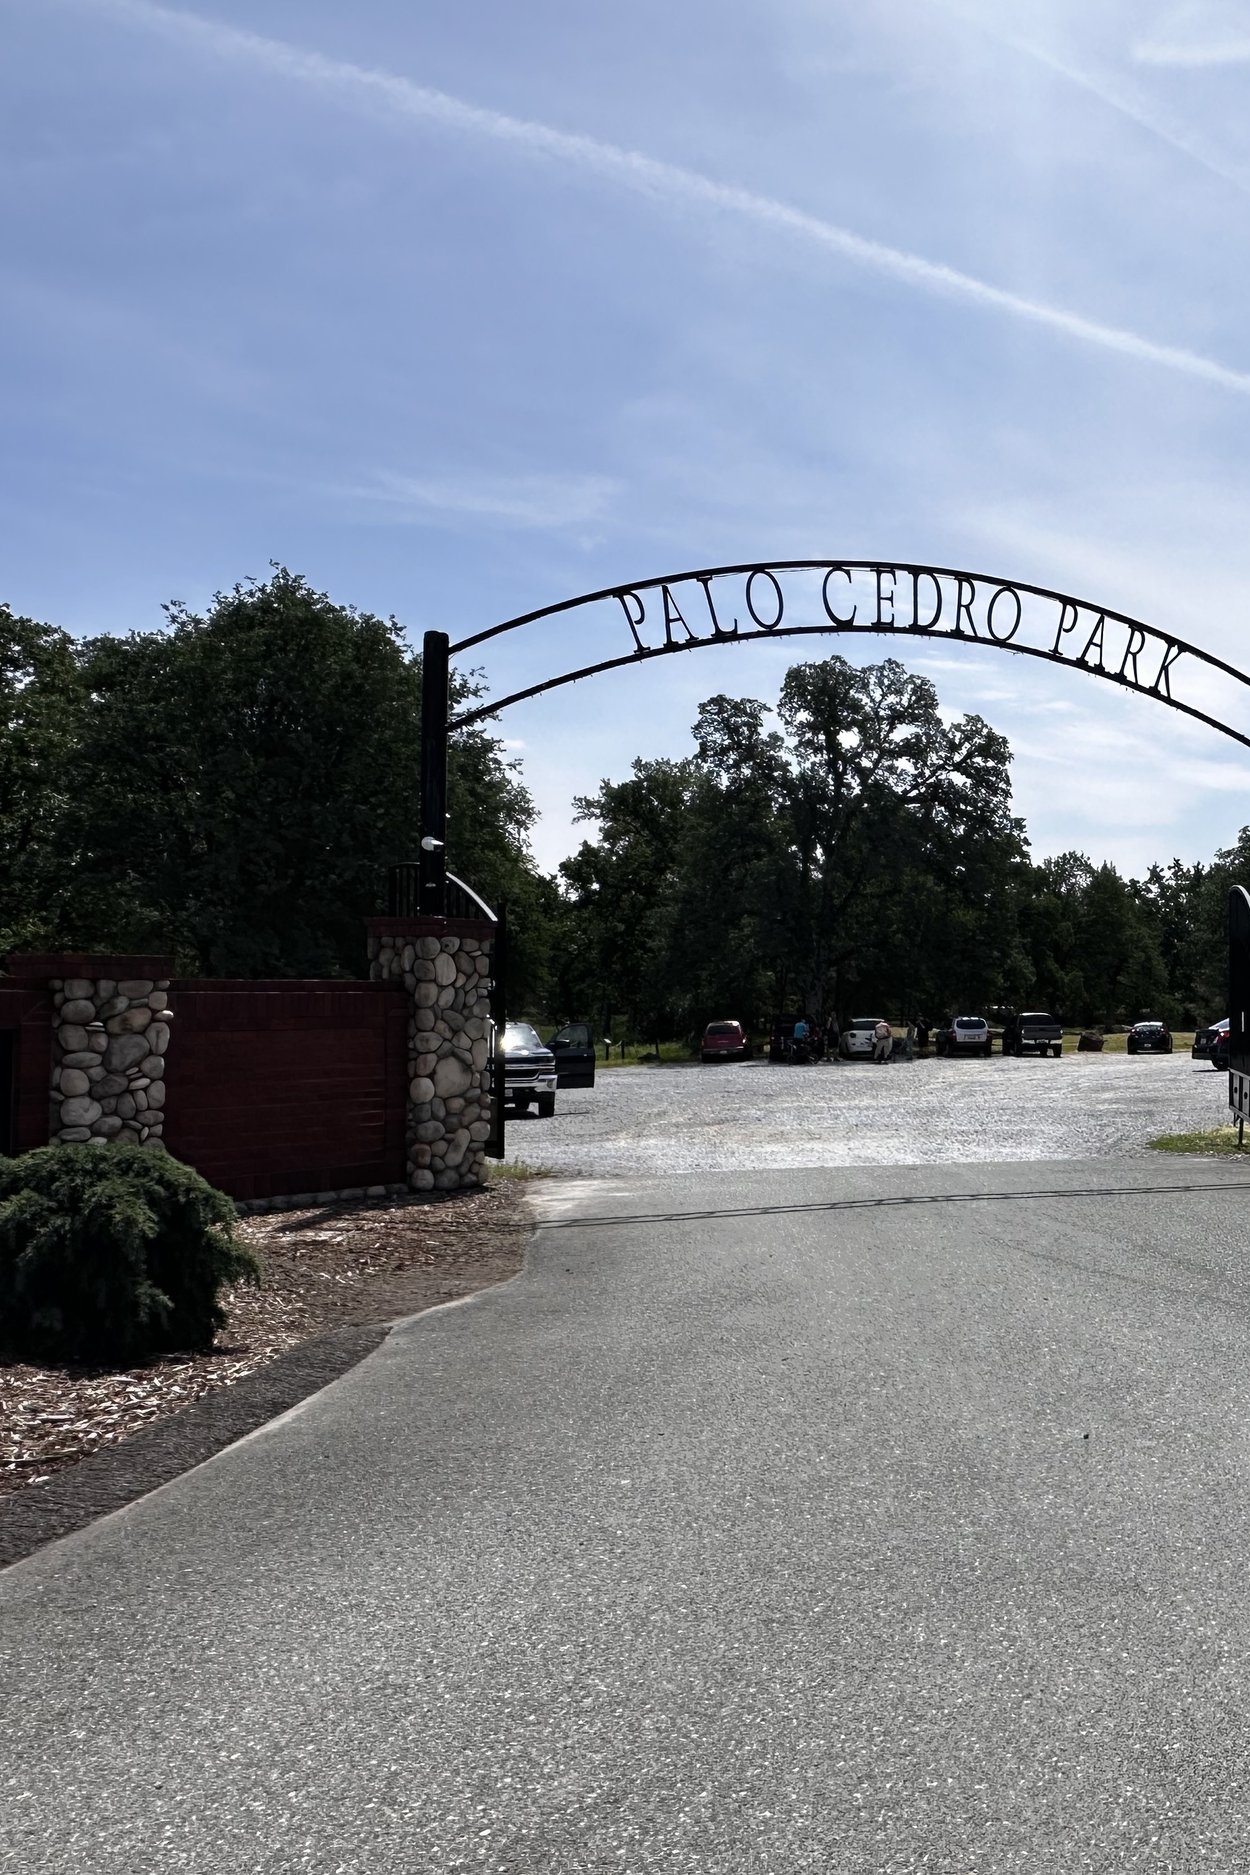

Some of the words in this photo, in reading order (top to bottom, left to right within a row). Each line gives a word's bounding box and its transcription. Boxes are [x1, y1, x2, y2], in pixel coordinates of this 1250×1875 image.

[613, 569, 784, 655] PALO
[822, 567, 1022, 642] CEDRO
[1048, 599, 1189, 700] PARK
